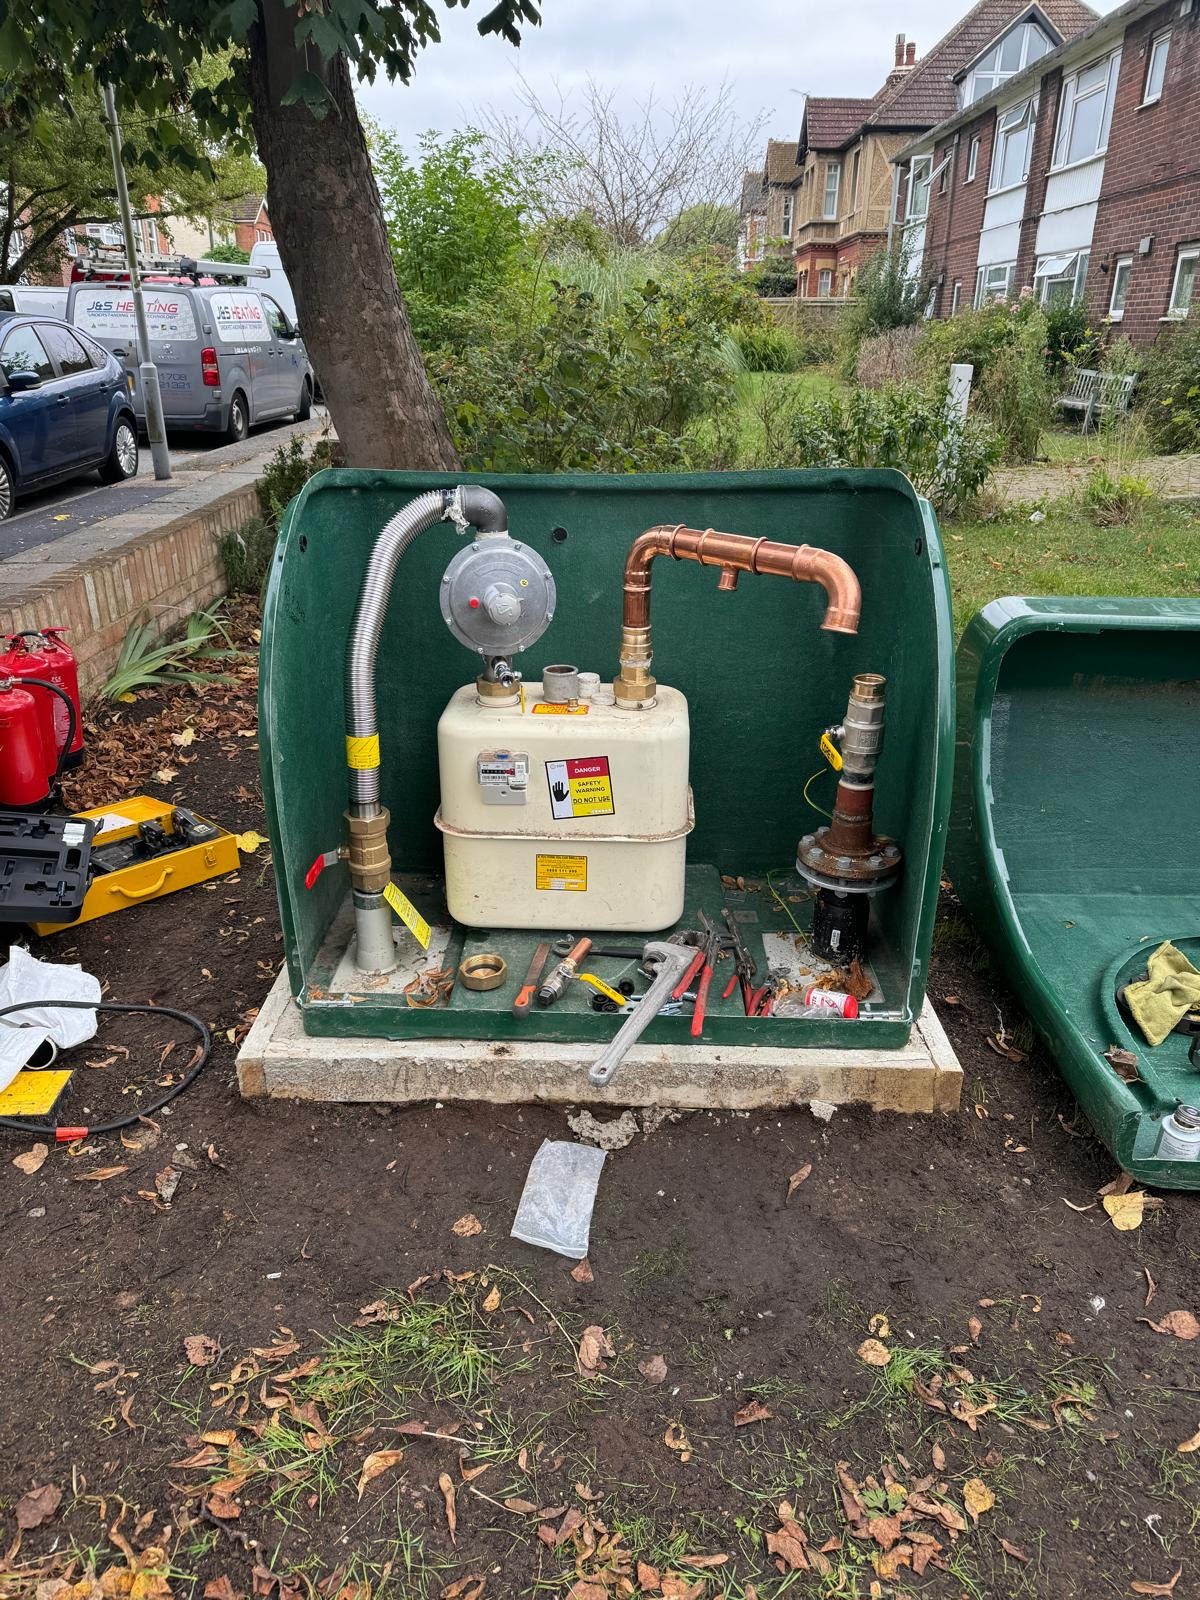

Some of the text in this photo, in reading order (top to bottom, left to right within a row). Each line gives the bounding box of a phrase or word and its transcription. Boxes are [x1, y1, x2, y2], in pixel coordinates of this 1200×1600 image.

[87, 301, 179, 313] J&S HETING
[217, 306, 261, 320] J&S HEATING
[574, 766, 601, 774] DANGER
[575, 786, 606, 794] WARNING
